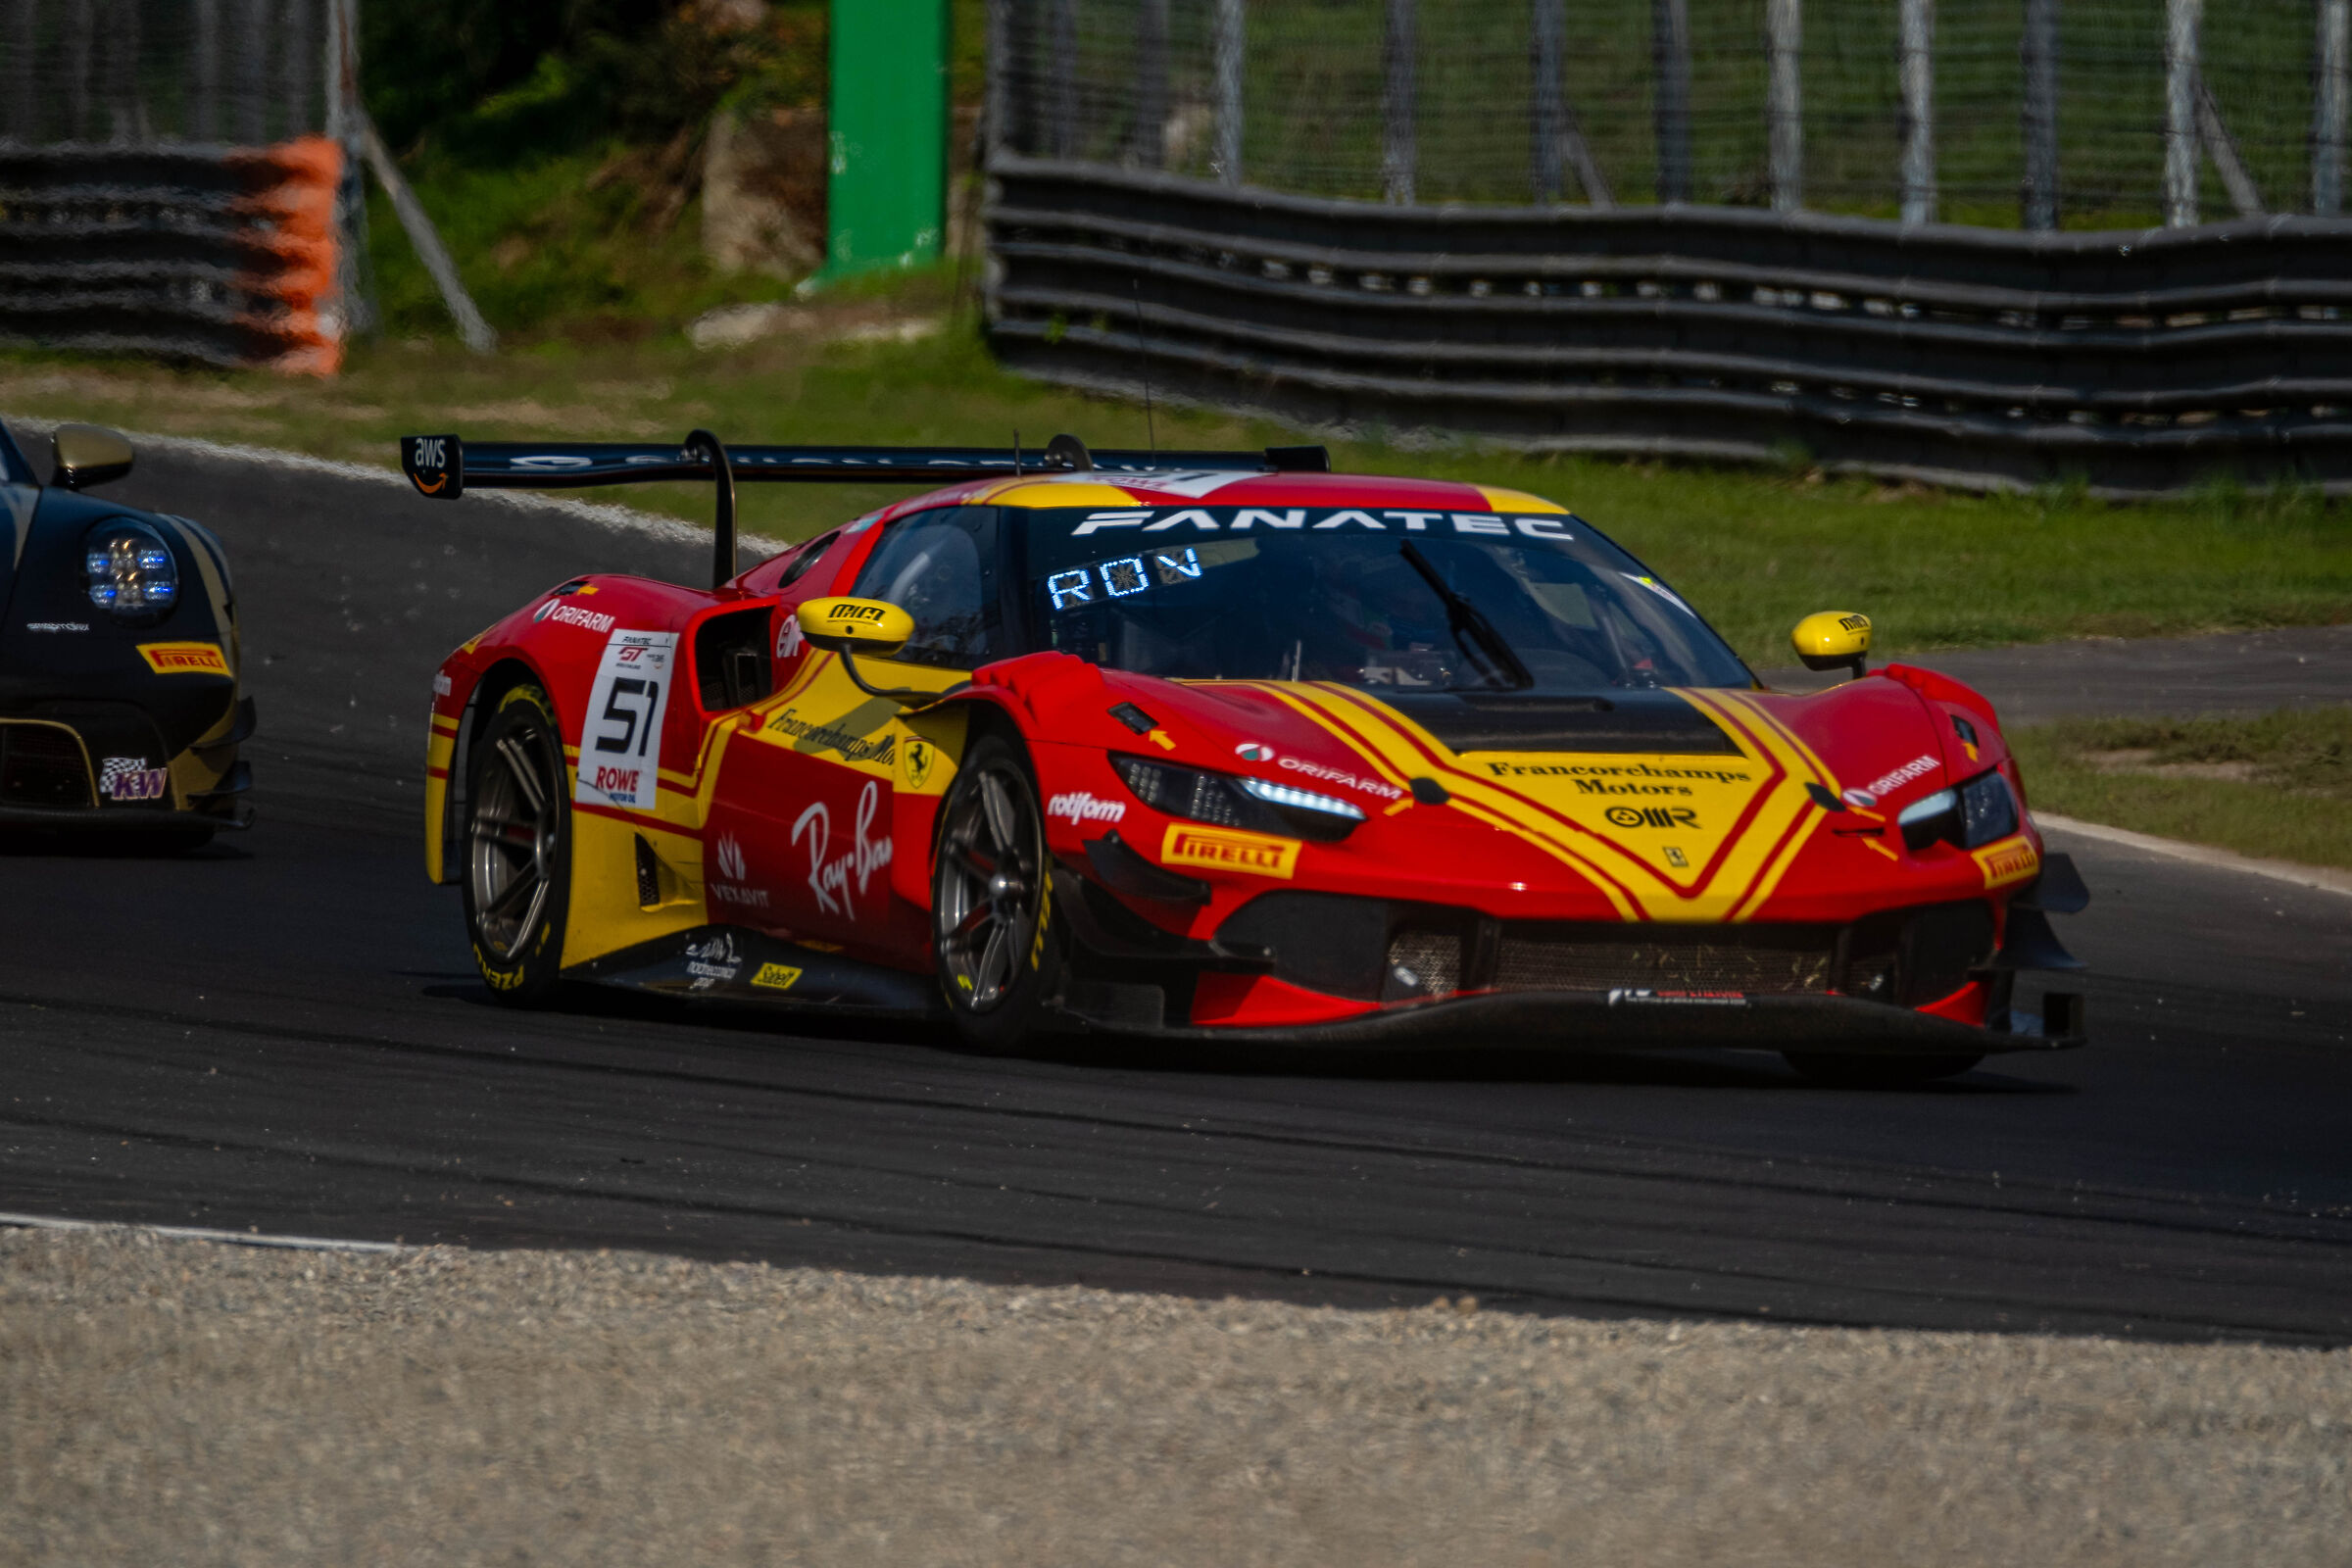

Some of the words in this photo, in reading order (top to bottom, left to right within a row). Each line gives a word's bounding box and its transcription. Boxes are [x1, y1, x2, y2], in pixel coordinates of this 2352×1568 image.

[415, 437, 446, 467] aws
[1071, 510, 1574, 541] FANATEC
[1047, 547, 1203, 611] ROV
[551, 605, 616, 634] ORIFARM
[149, 649, 224, 669] PIRELLI
[594, 676, 660, 757] 51
[111, 767, 168, 801] KW
[595, 765, 640, 792] ROWE
[1278, 757, 1405, 801] ORIFARM
[1485, 760, 1752, 785] Francorchamps
[1571, 778, 1693, 798] Motors
[1868, 754, 1941, 796] ORIFARM
[1172, 832, 1287, 869] PIRELLI
[1984, 844, 2036, 879] PIRELLI
